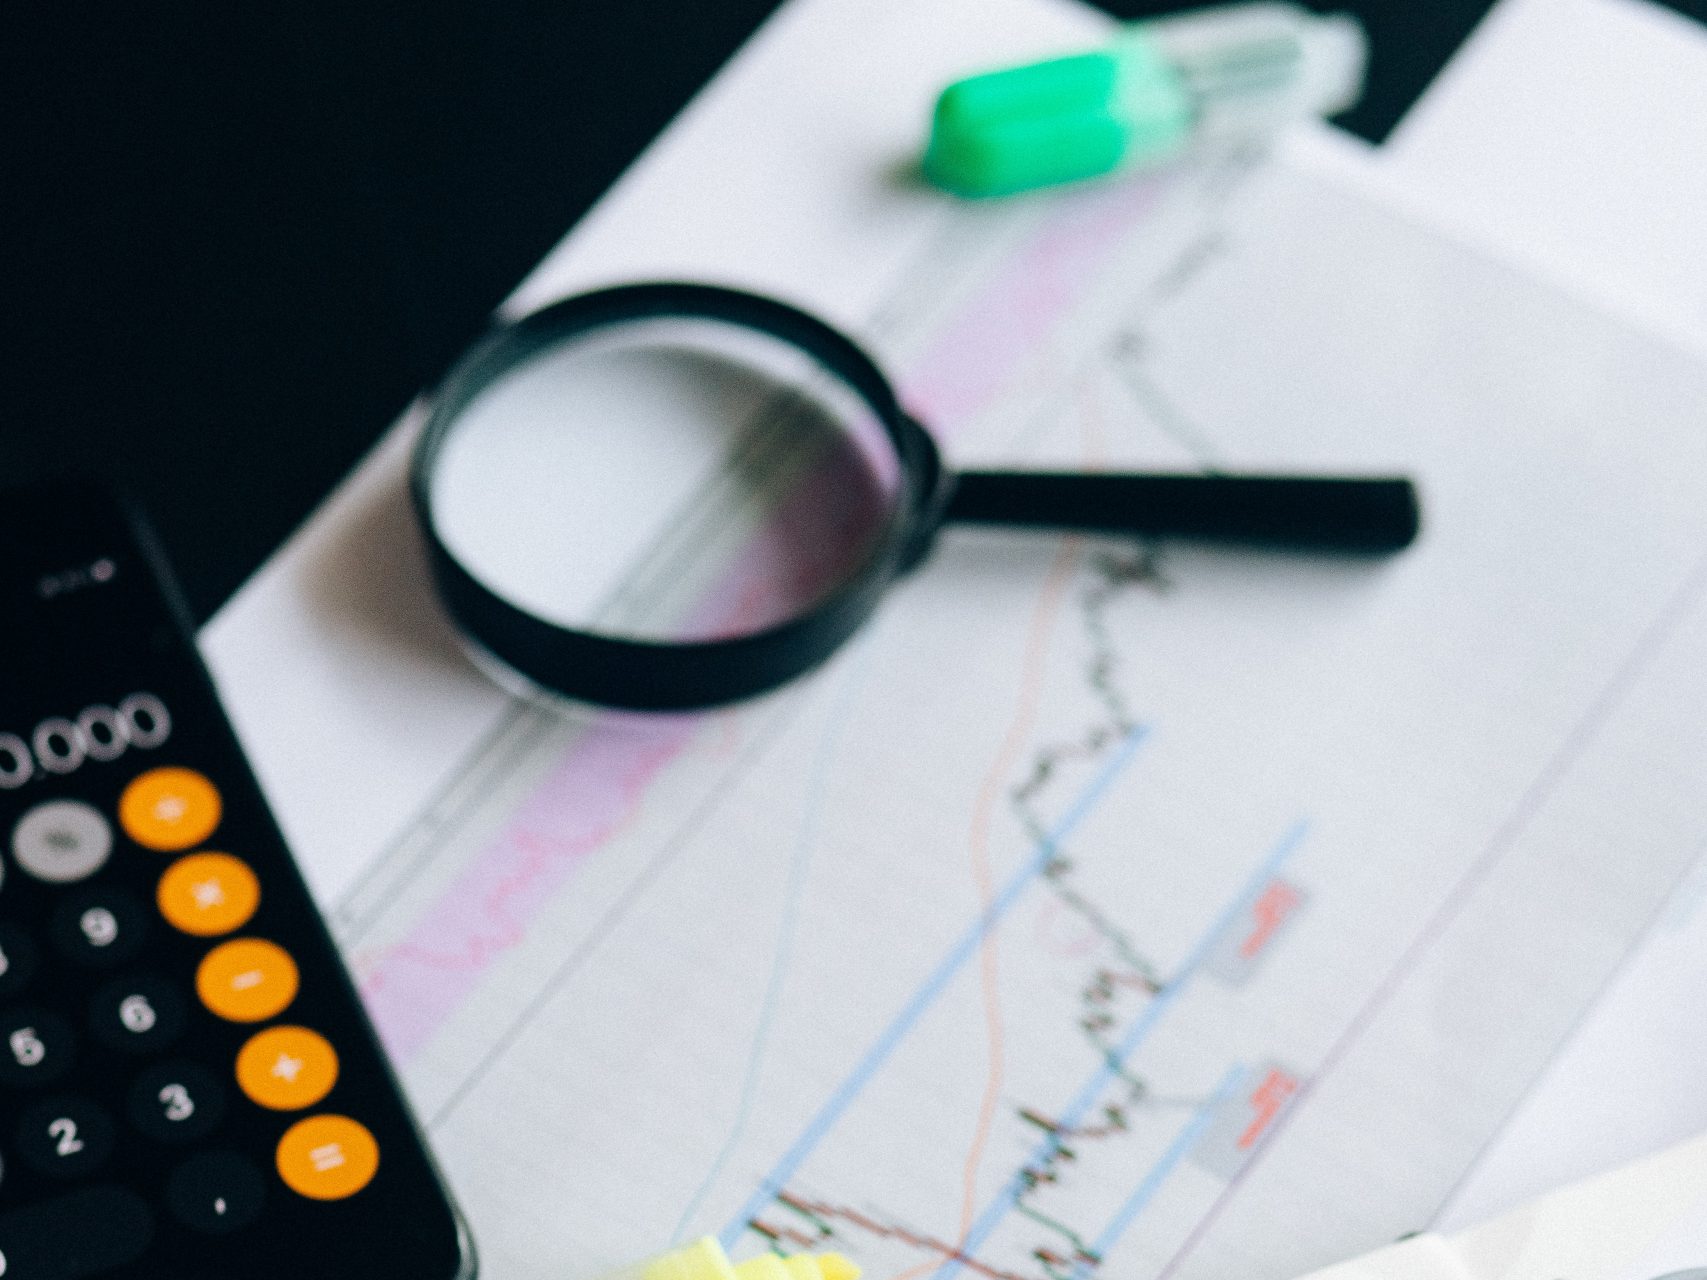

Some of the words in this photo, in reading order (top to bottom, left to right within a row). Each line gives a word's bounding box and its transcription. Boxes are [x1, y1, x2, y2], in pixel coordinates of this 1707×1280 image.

[80, 907, 118, 947] 9
[119, 994, 156, 1033] 6
[9, 1026, 45, 1067] 5
[158, 1083, 195, 1122] 3
[48, 1117, 84, 1157] 2
